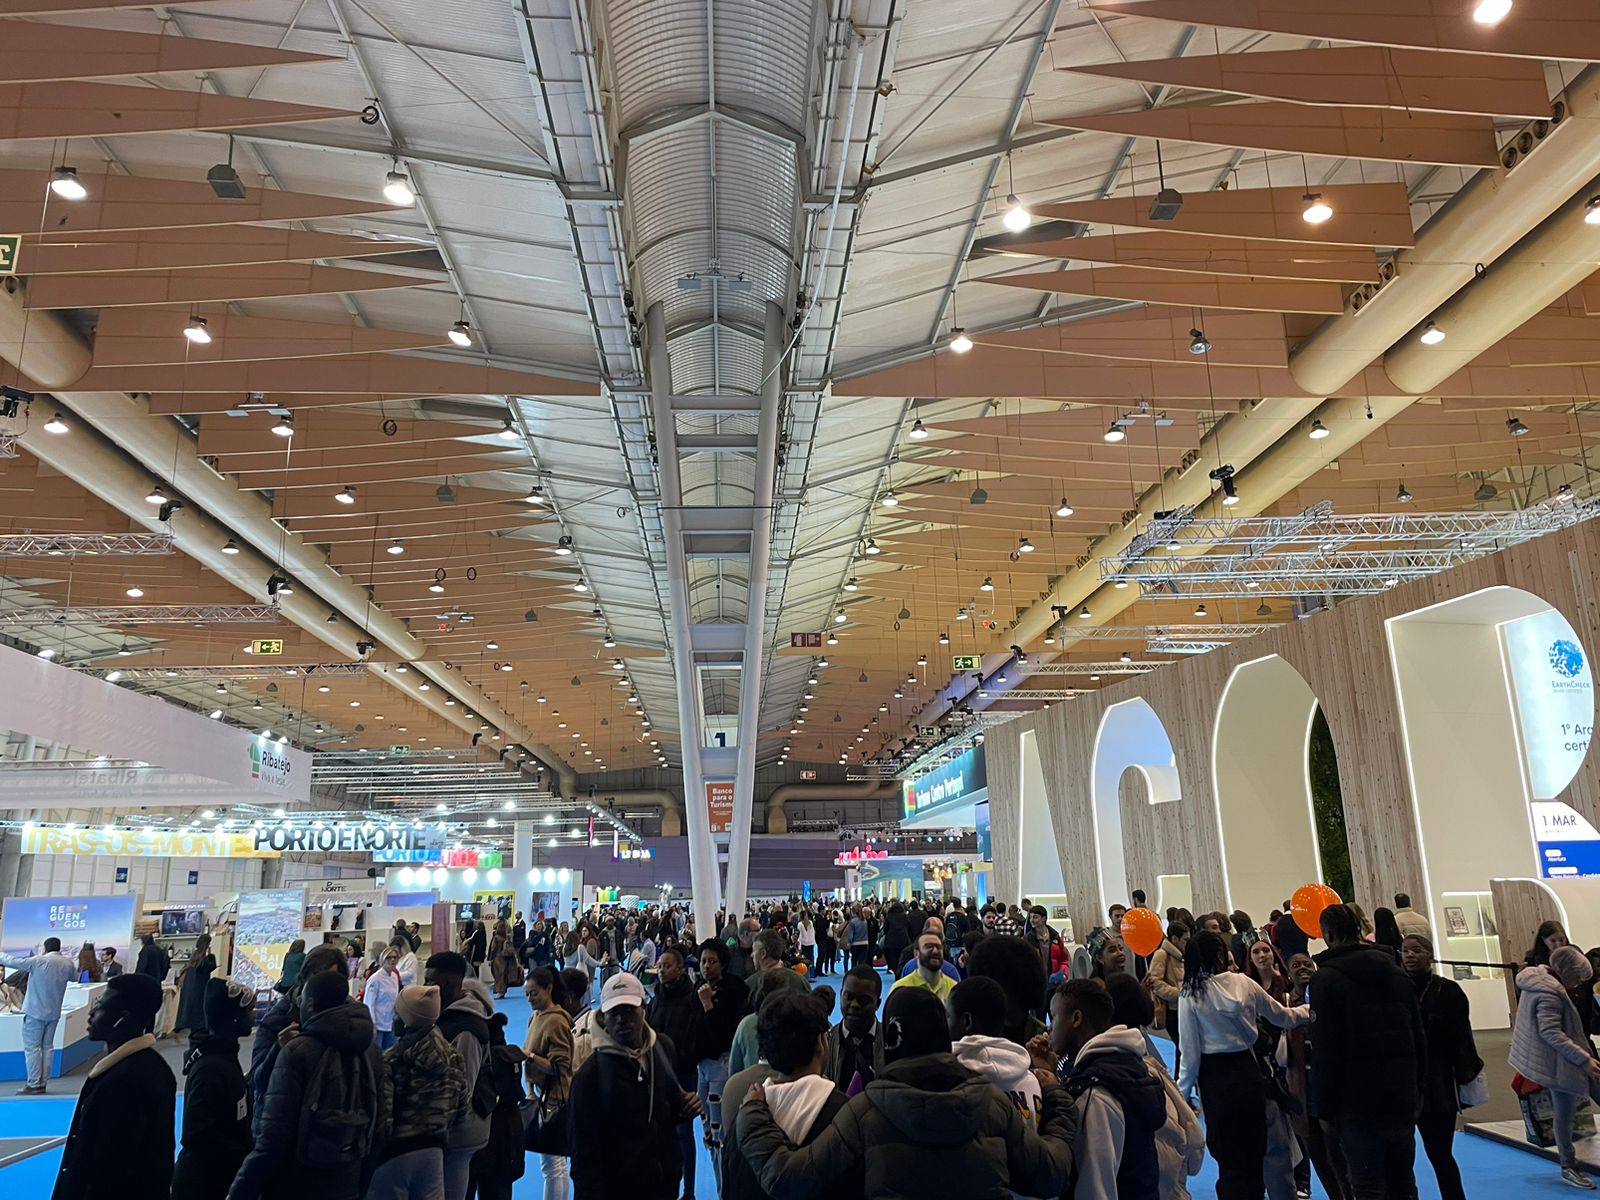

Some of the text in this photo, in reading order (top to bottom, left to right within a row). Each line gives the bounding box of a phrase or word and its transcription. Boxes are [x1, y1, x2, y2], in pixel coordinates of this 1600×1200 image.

[714, 732, 726, 747] 1
[262, 751, 291, 775] Ribatejo
[1553, 815, 1577, 826] MAR
[50, 905, 65, 914] RE
[49, 912, 80, 921] GUEN
[63, 920, 86, 928] GOS
